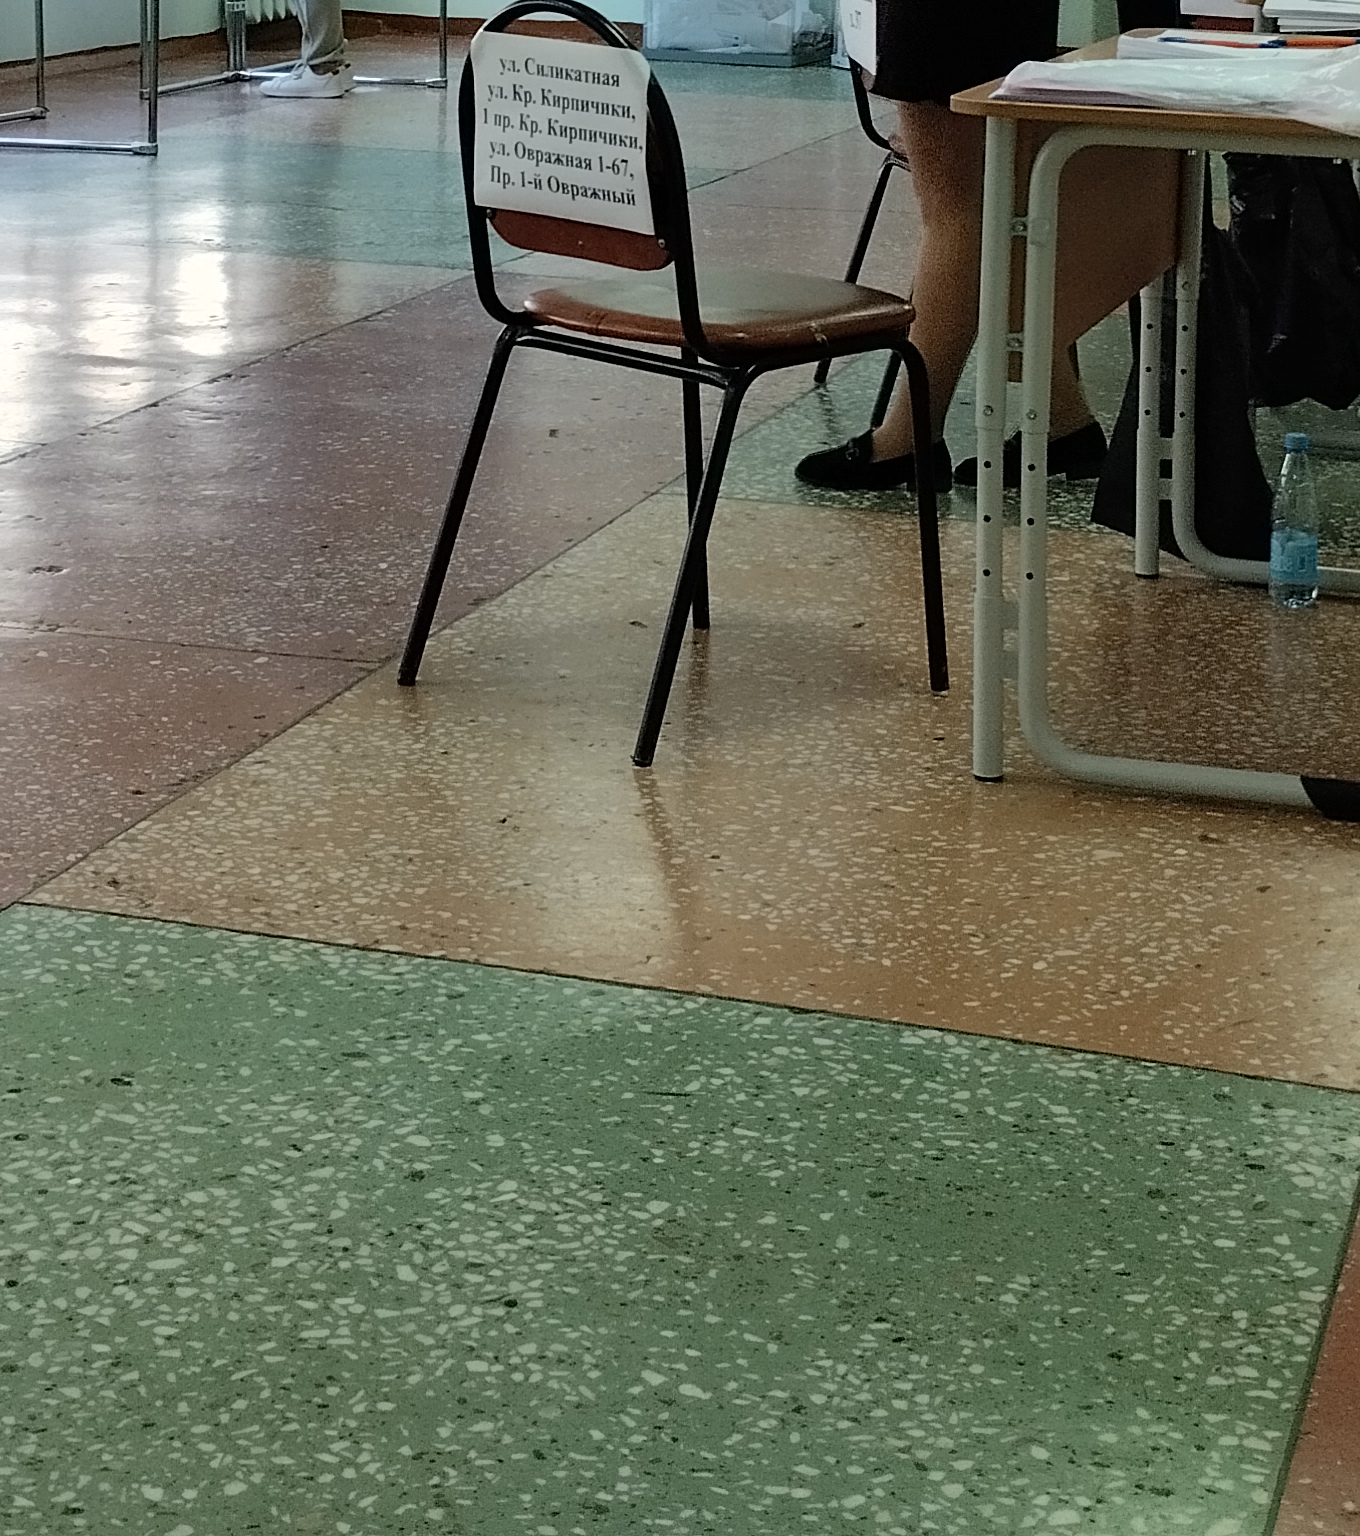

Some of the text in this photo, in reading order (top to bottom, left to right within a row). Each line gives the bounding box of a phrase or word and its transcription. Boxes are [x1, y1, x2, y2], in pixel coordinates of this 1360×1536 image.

[499, 57, 621, 87] ул. Силикатная
[487, 83, 636, 123] ул. Кр. Кирпичики,
[482, 108, 643, 153] 1 пр. Кр. Кирпичики,
[489, 140, 635, 181] ул. Овражная 1-67,
[490, 165, 636, 206] Пр. 1-й Овражный
